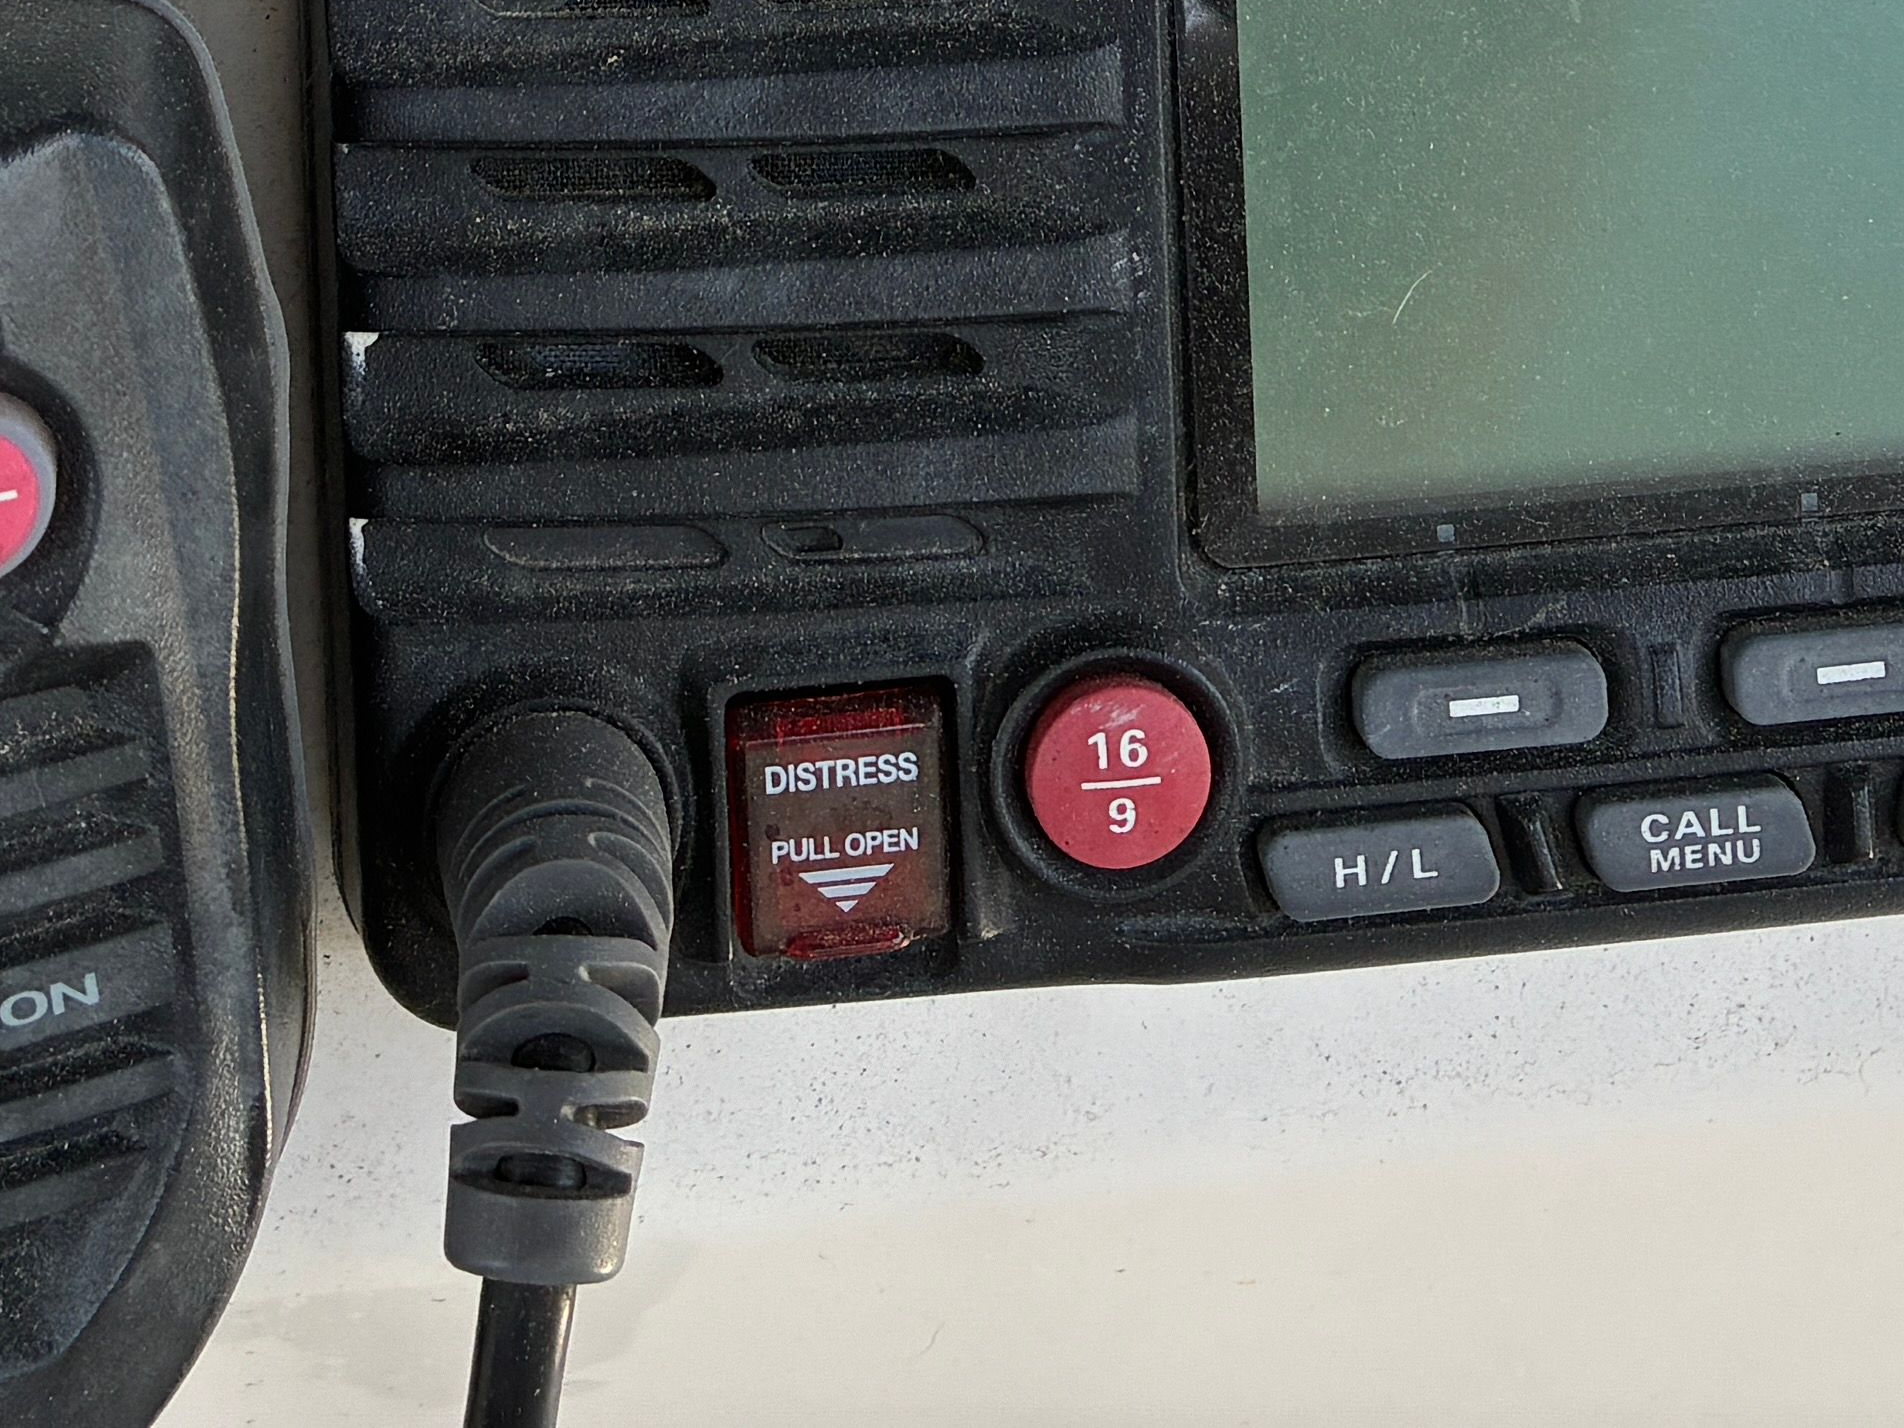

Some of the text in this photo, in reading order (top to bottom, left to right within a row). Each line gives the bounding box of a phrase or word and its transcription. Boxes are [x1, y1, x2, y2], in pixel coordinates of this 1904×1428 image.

[1087, 728, 1149, 770] 16
[764, 751, 919, 795] DISTRESS
[1108, 798, 1138, 834] 9
[1640, 807, 1761, 843] CALL
[771, 827, 919, 864] PULL OPEN
[1649, 838, 1762, 872] MENU
